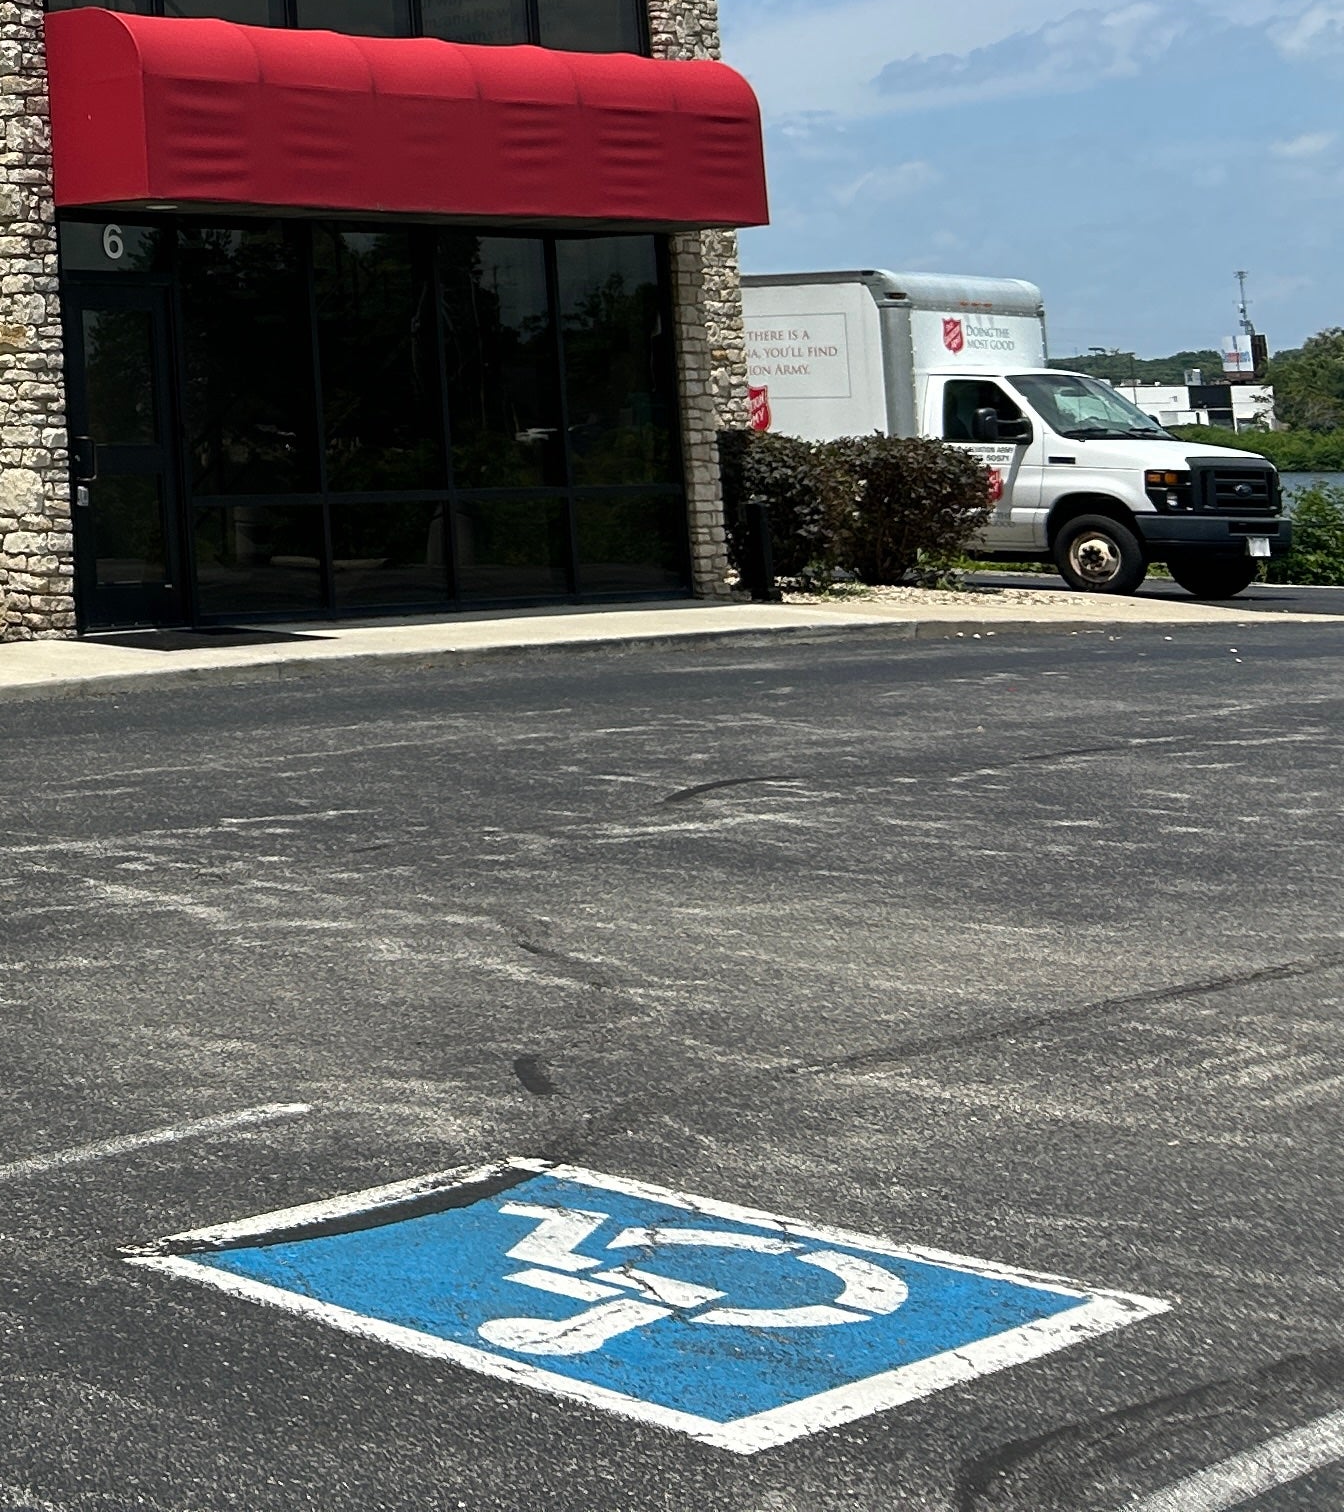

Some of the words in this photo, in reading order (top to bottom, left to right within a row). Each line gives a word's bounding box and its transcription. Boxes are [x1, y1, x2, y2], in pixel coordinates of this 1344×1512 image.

[103, 223, 124, 260] 6
[747, 330, 784, 342] THERE
[788, 330, 798, 341] IS
[801, 330, 810, 341] A
[763, 345, 805, 359] YOU'LL
[807, 346, 838, 358] FIND
